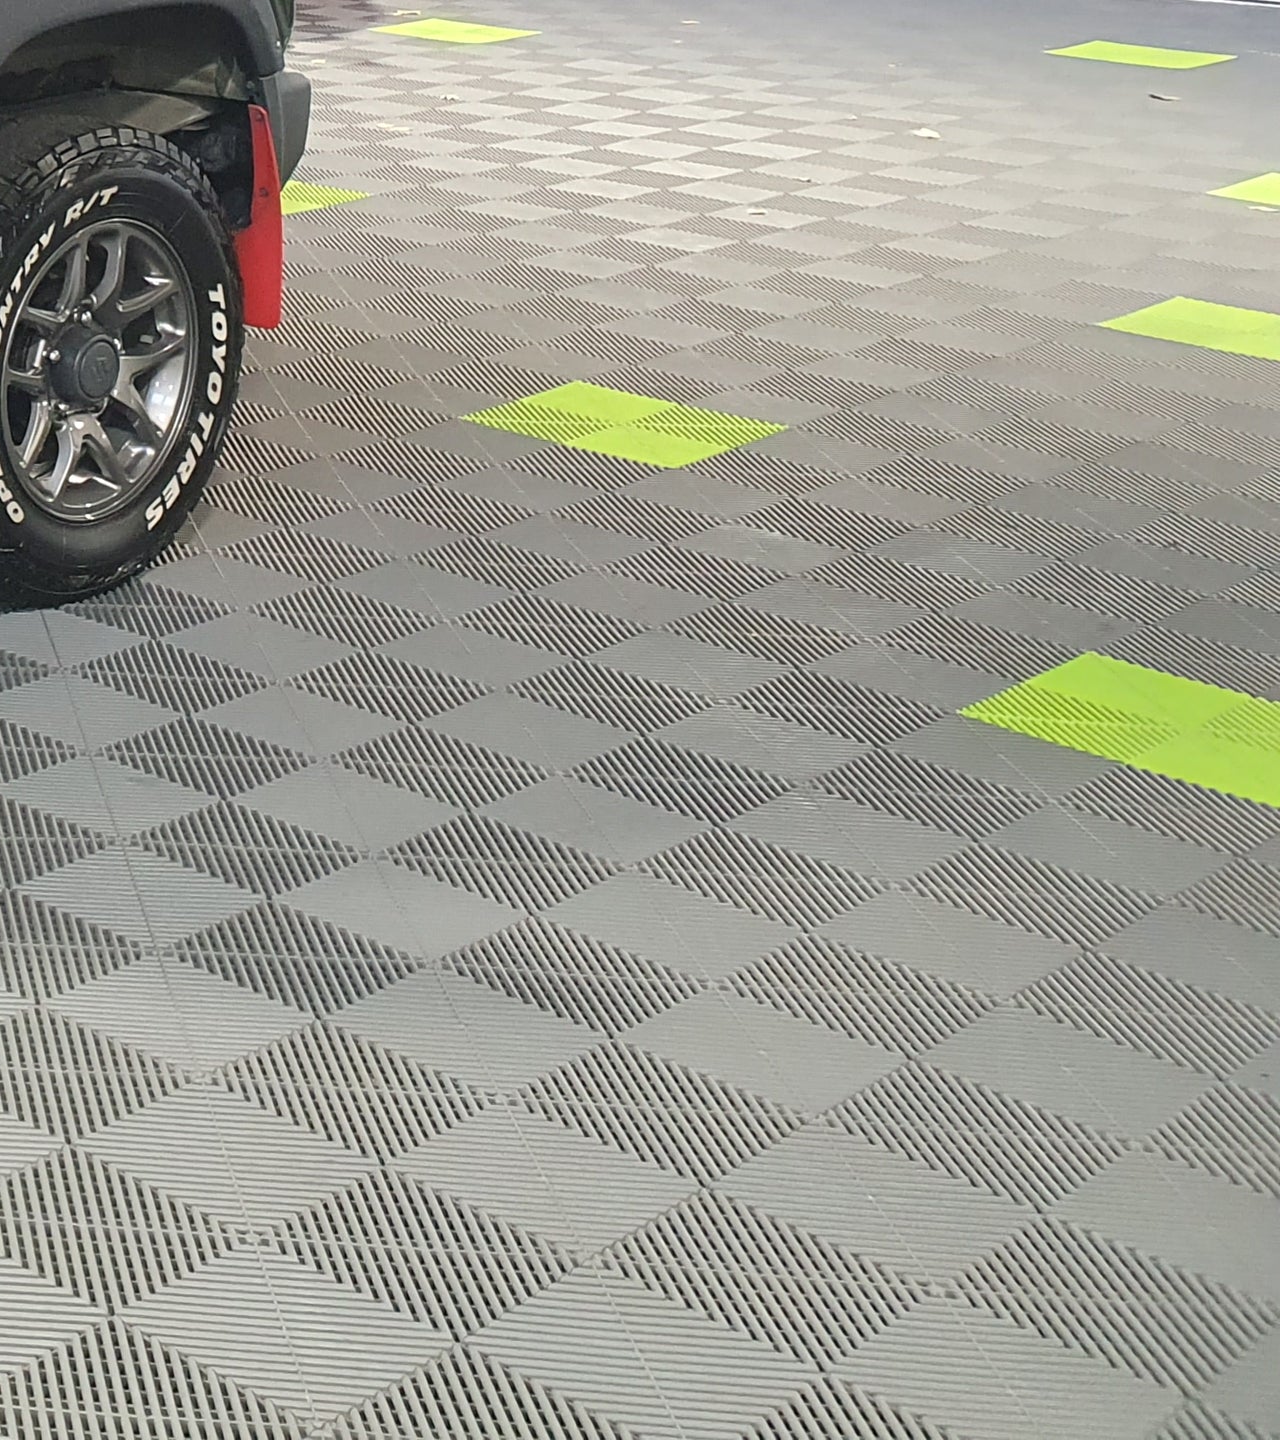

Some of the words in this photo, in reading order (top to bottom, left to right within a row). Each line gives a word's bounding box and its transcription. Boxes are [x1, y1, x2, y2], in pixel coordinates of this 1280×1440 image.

[63, 183, 121, 229] R/T
[204, 282, 229, 406] TOYO
[145, 413, 214, 531] TIRES
